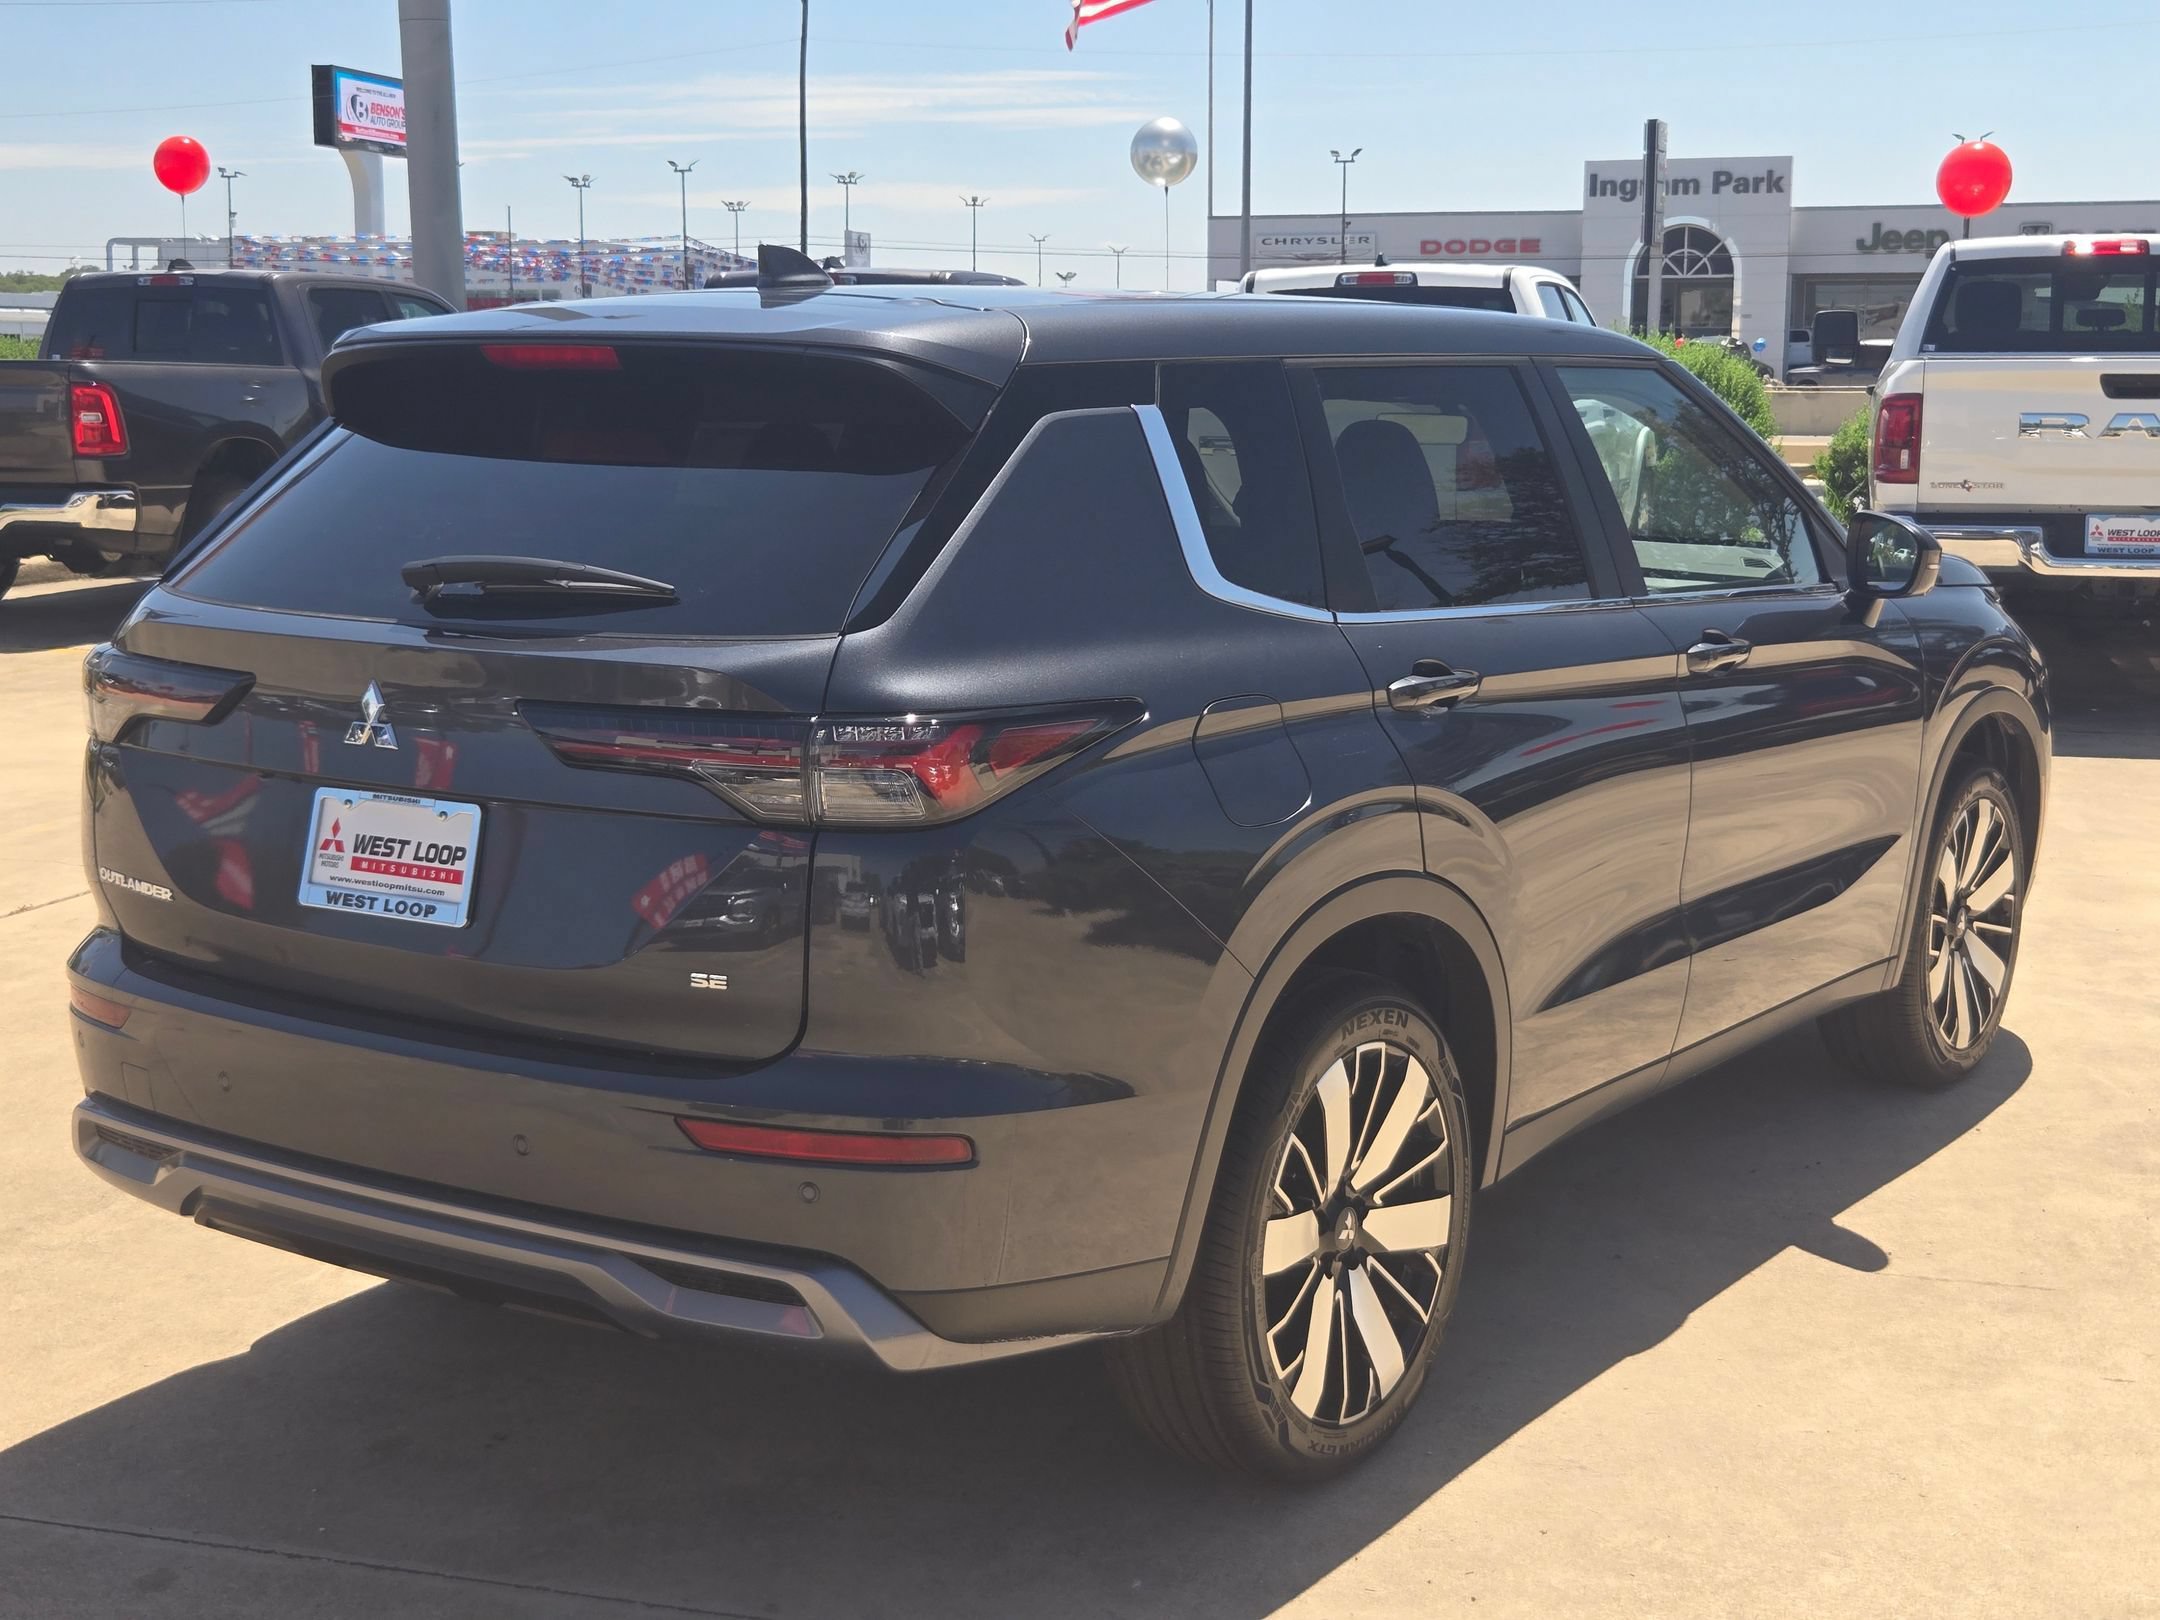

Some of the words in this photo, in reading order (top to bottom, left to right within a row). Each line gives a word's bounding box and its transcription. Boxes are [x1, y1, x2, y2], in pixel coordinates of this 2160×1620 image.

[370, 116, 386, 127] AUTO
[1589, 173, 1700, 203] Ingm
[1711, 169, 1785, 195] Park
[1261, 236, 1370, 246] CHRYSLER
[1420, 238, 1541, 255] DODGE
[1856, 222, 1950, 259] Jeep
[2107, 528, 2136, 537] WEST
[372, 793, 421, 805] MITSUBISHI
[353, 833, 411, 860] WEST
[413, 841, 467, 867] LOOP
[360, 861, 455, 881] MITSUBISHI
[99, 867, 175, 902] OUTLANDER
[329, 874, 446, 897] www.westloopmitsu.com
[325, 890, 380, 911] WEST
[383, 898, 438, 918] LOOP
[690, 972, 728, 990] SE
[1341, 1008, 1409, 1041] NEXEN
[1307, 1439, 1337, 1456] GTX
